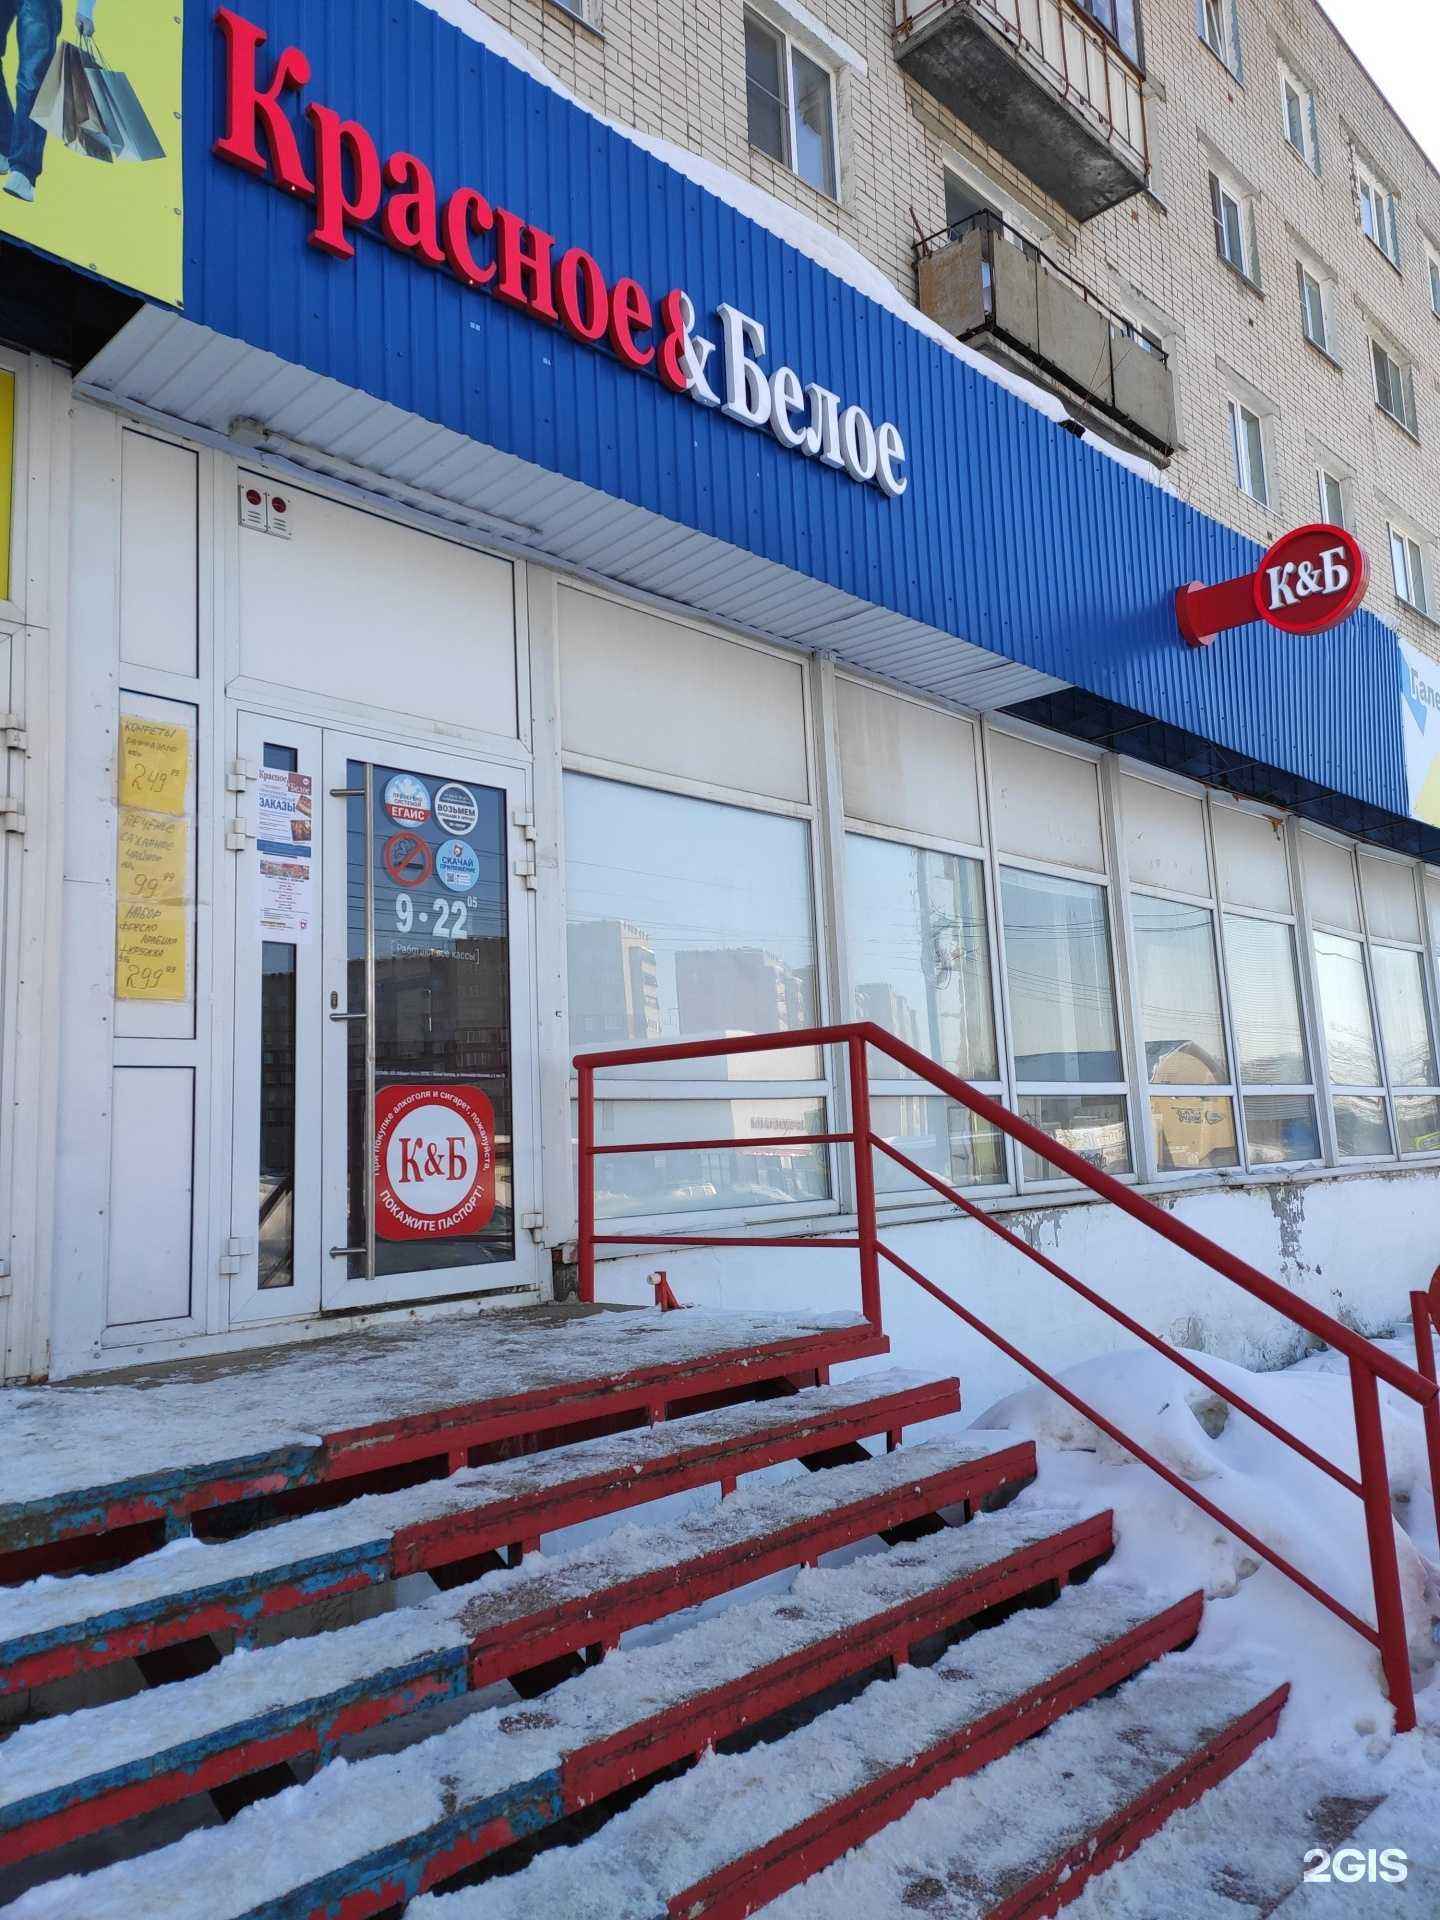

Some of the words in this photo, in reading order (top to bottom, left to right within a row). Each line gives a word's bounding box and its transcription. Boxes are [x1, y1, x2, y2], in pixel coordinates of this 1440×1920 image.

[1266, 546, 1350, 610] К&Б
[131, 763, 168, 793] 249
[259, 797, 296, 812] ЗАКАЗЫ
[392, 806, 425, 821] ЕГАИС
[441, 856, 474, 867] СКАЧАЙ
[129, 873, 159, 898] 99
[126, 964, 164, 989] 299
[394, 1091, 431, 1113] алкоголя
[399, 1137, 468, 1183] К&Б
[379, 1189, 436, 1232] ПОКАЖИТЕ
[438, 1184, 485, 1230] ПАСПОРТ!
